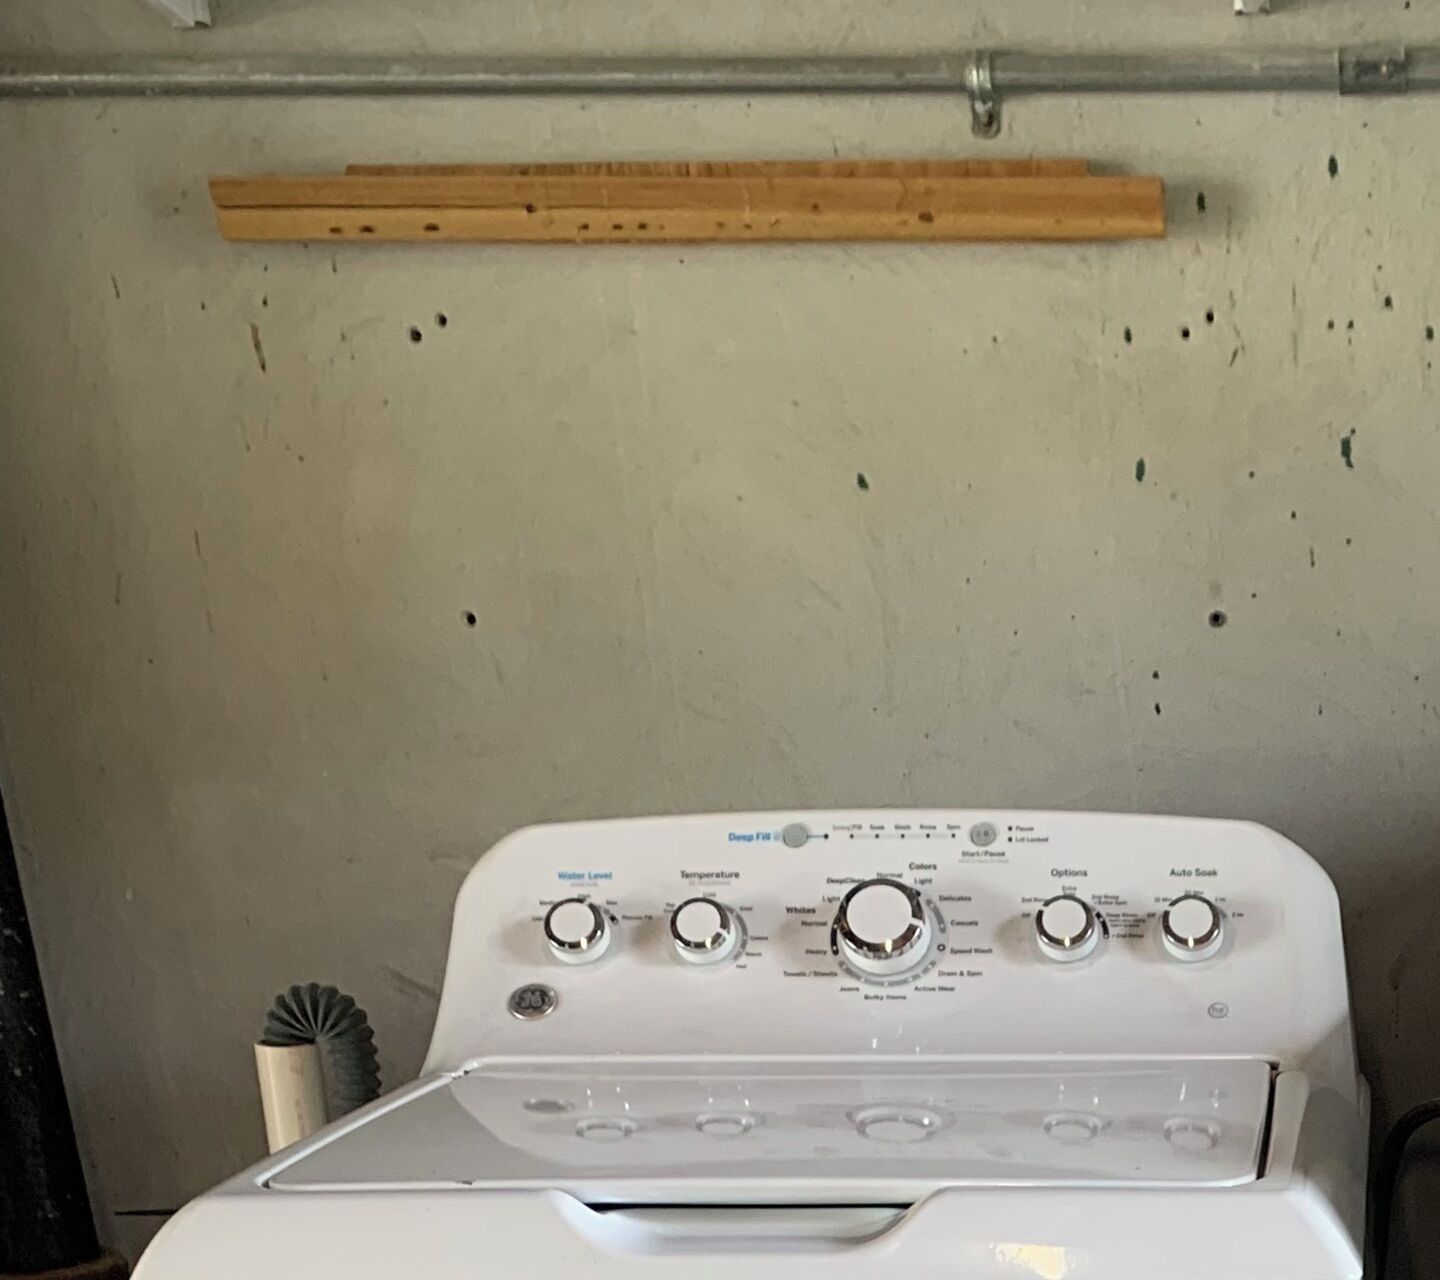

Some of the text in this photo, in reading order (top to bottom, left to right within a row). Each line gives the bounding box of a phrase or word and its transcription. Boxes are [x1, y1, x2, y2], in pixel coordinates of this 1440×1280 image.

[728, 831, 771, 843] Deep Fill
[908, 863, 938, 871] Colors
[1050, 867, 1089, 878] Options
[1169, 867, 1193, 877] Auto
[558, 869, 613, 880] Water Level
[679, 869, 741, 881] Temperature
[785, 906, 816, 915] Whites
